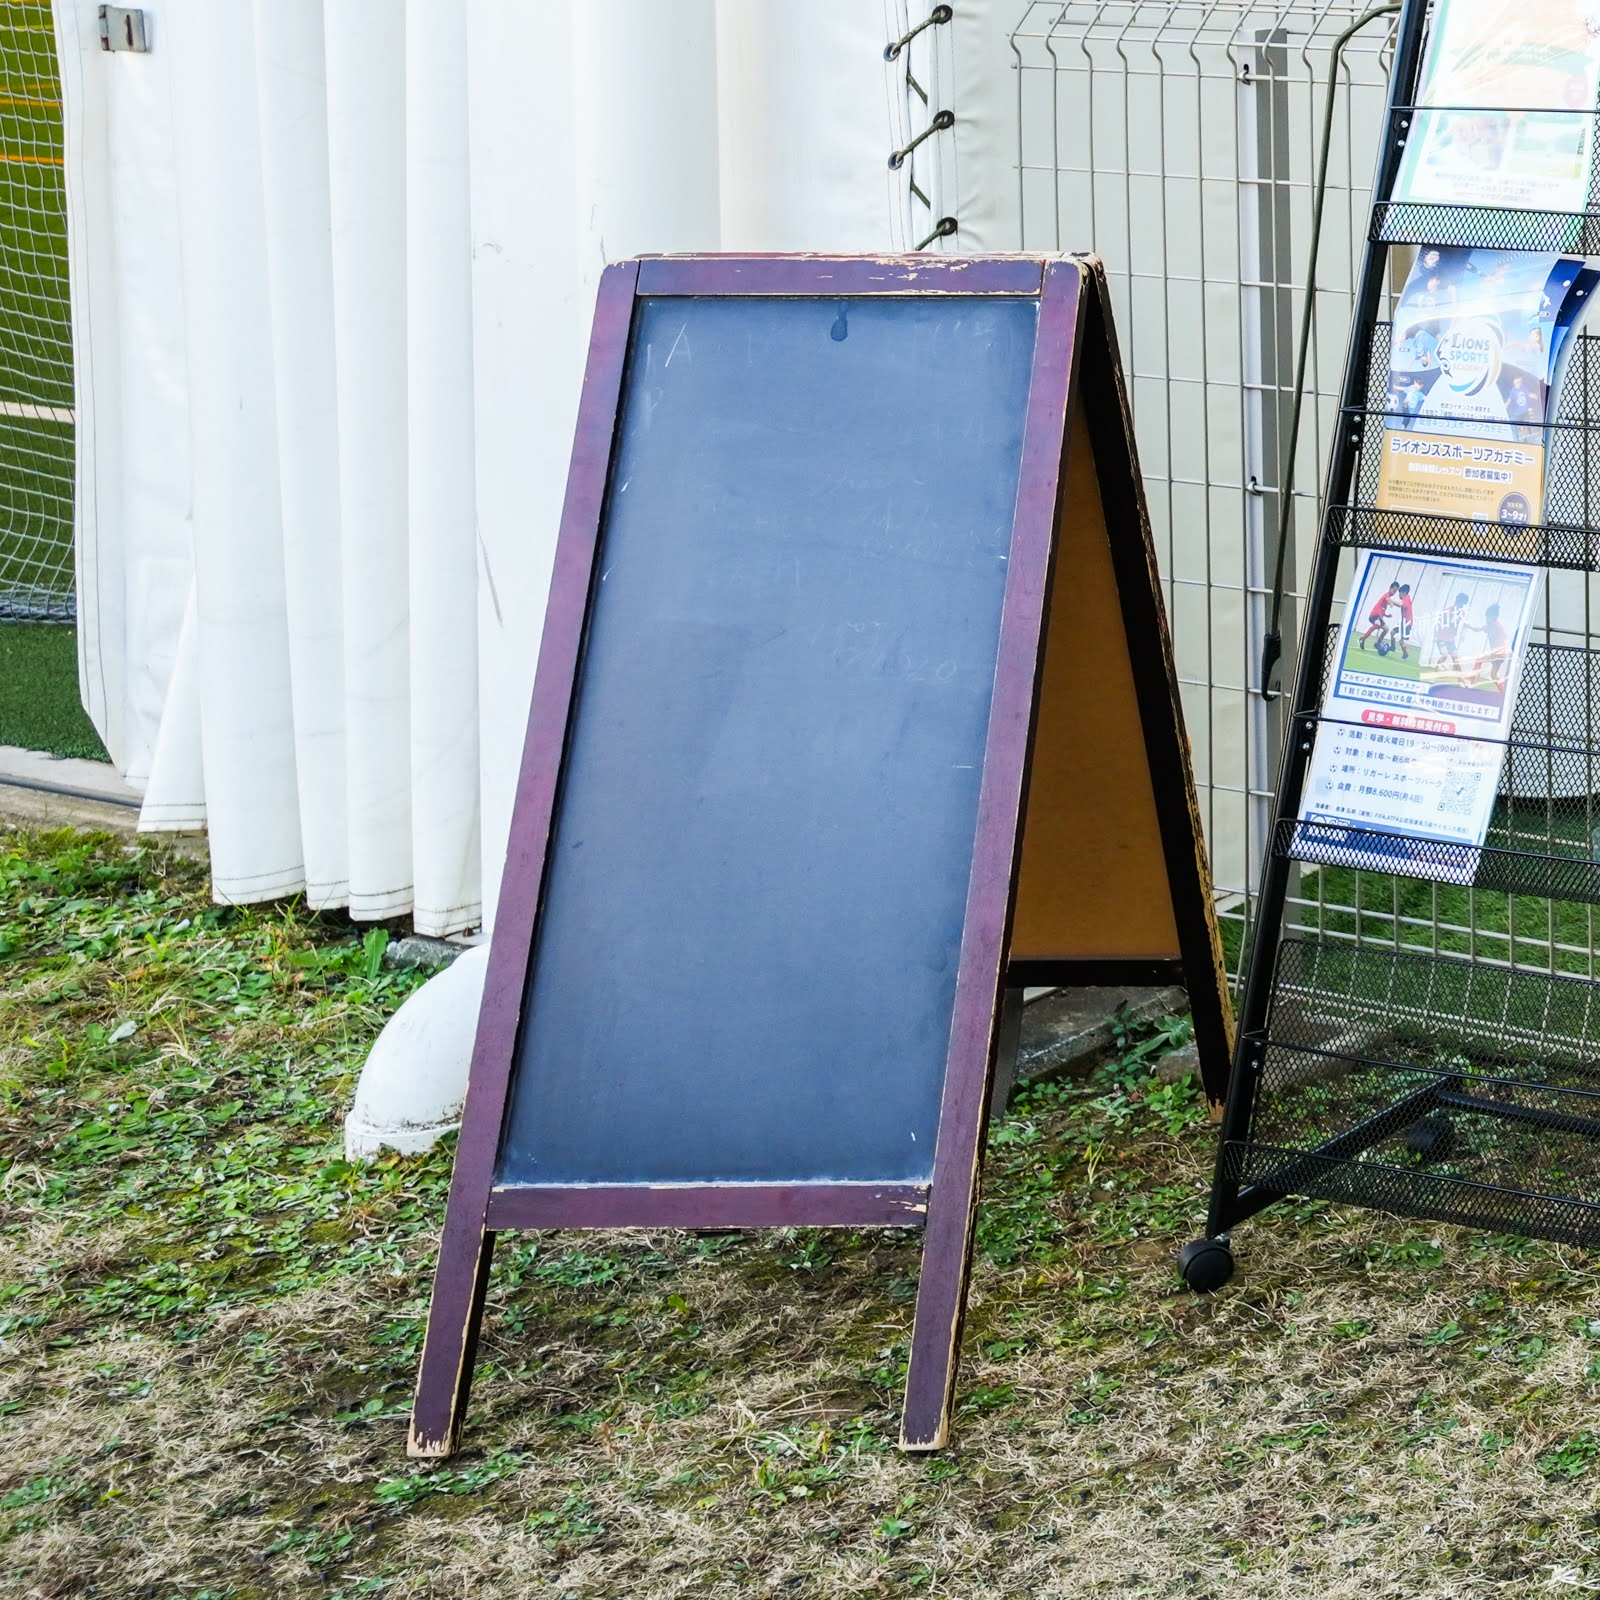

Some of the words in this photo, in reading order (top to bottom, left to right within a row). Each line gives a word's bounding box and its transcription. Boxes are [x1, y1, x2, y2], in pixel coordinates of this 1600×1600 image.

[1451, 332, 1490, 351] LIONS
[1449, 350, 1489, 364] SPORTS
[1391, 437, 1535, 466] ライオンズスポーツアカデミー
